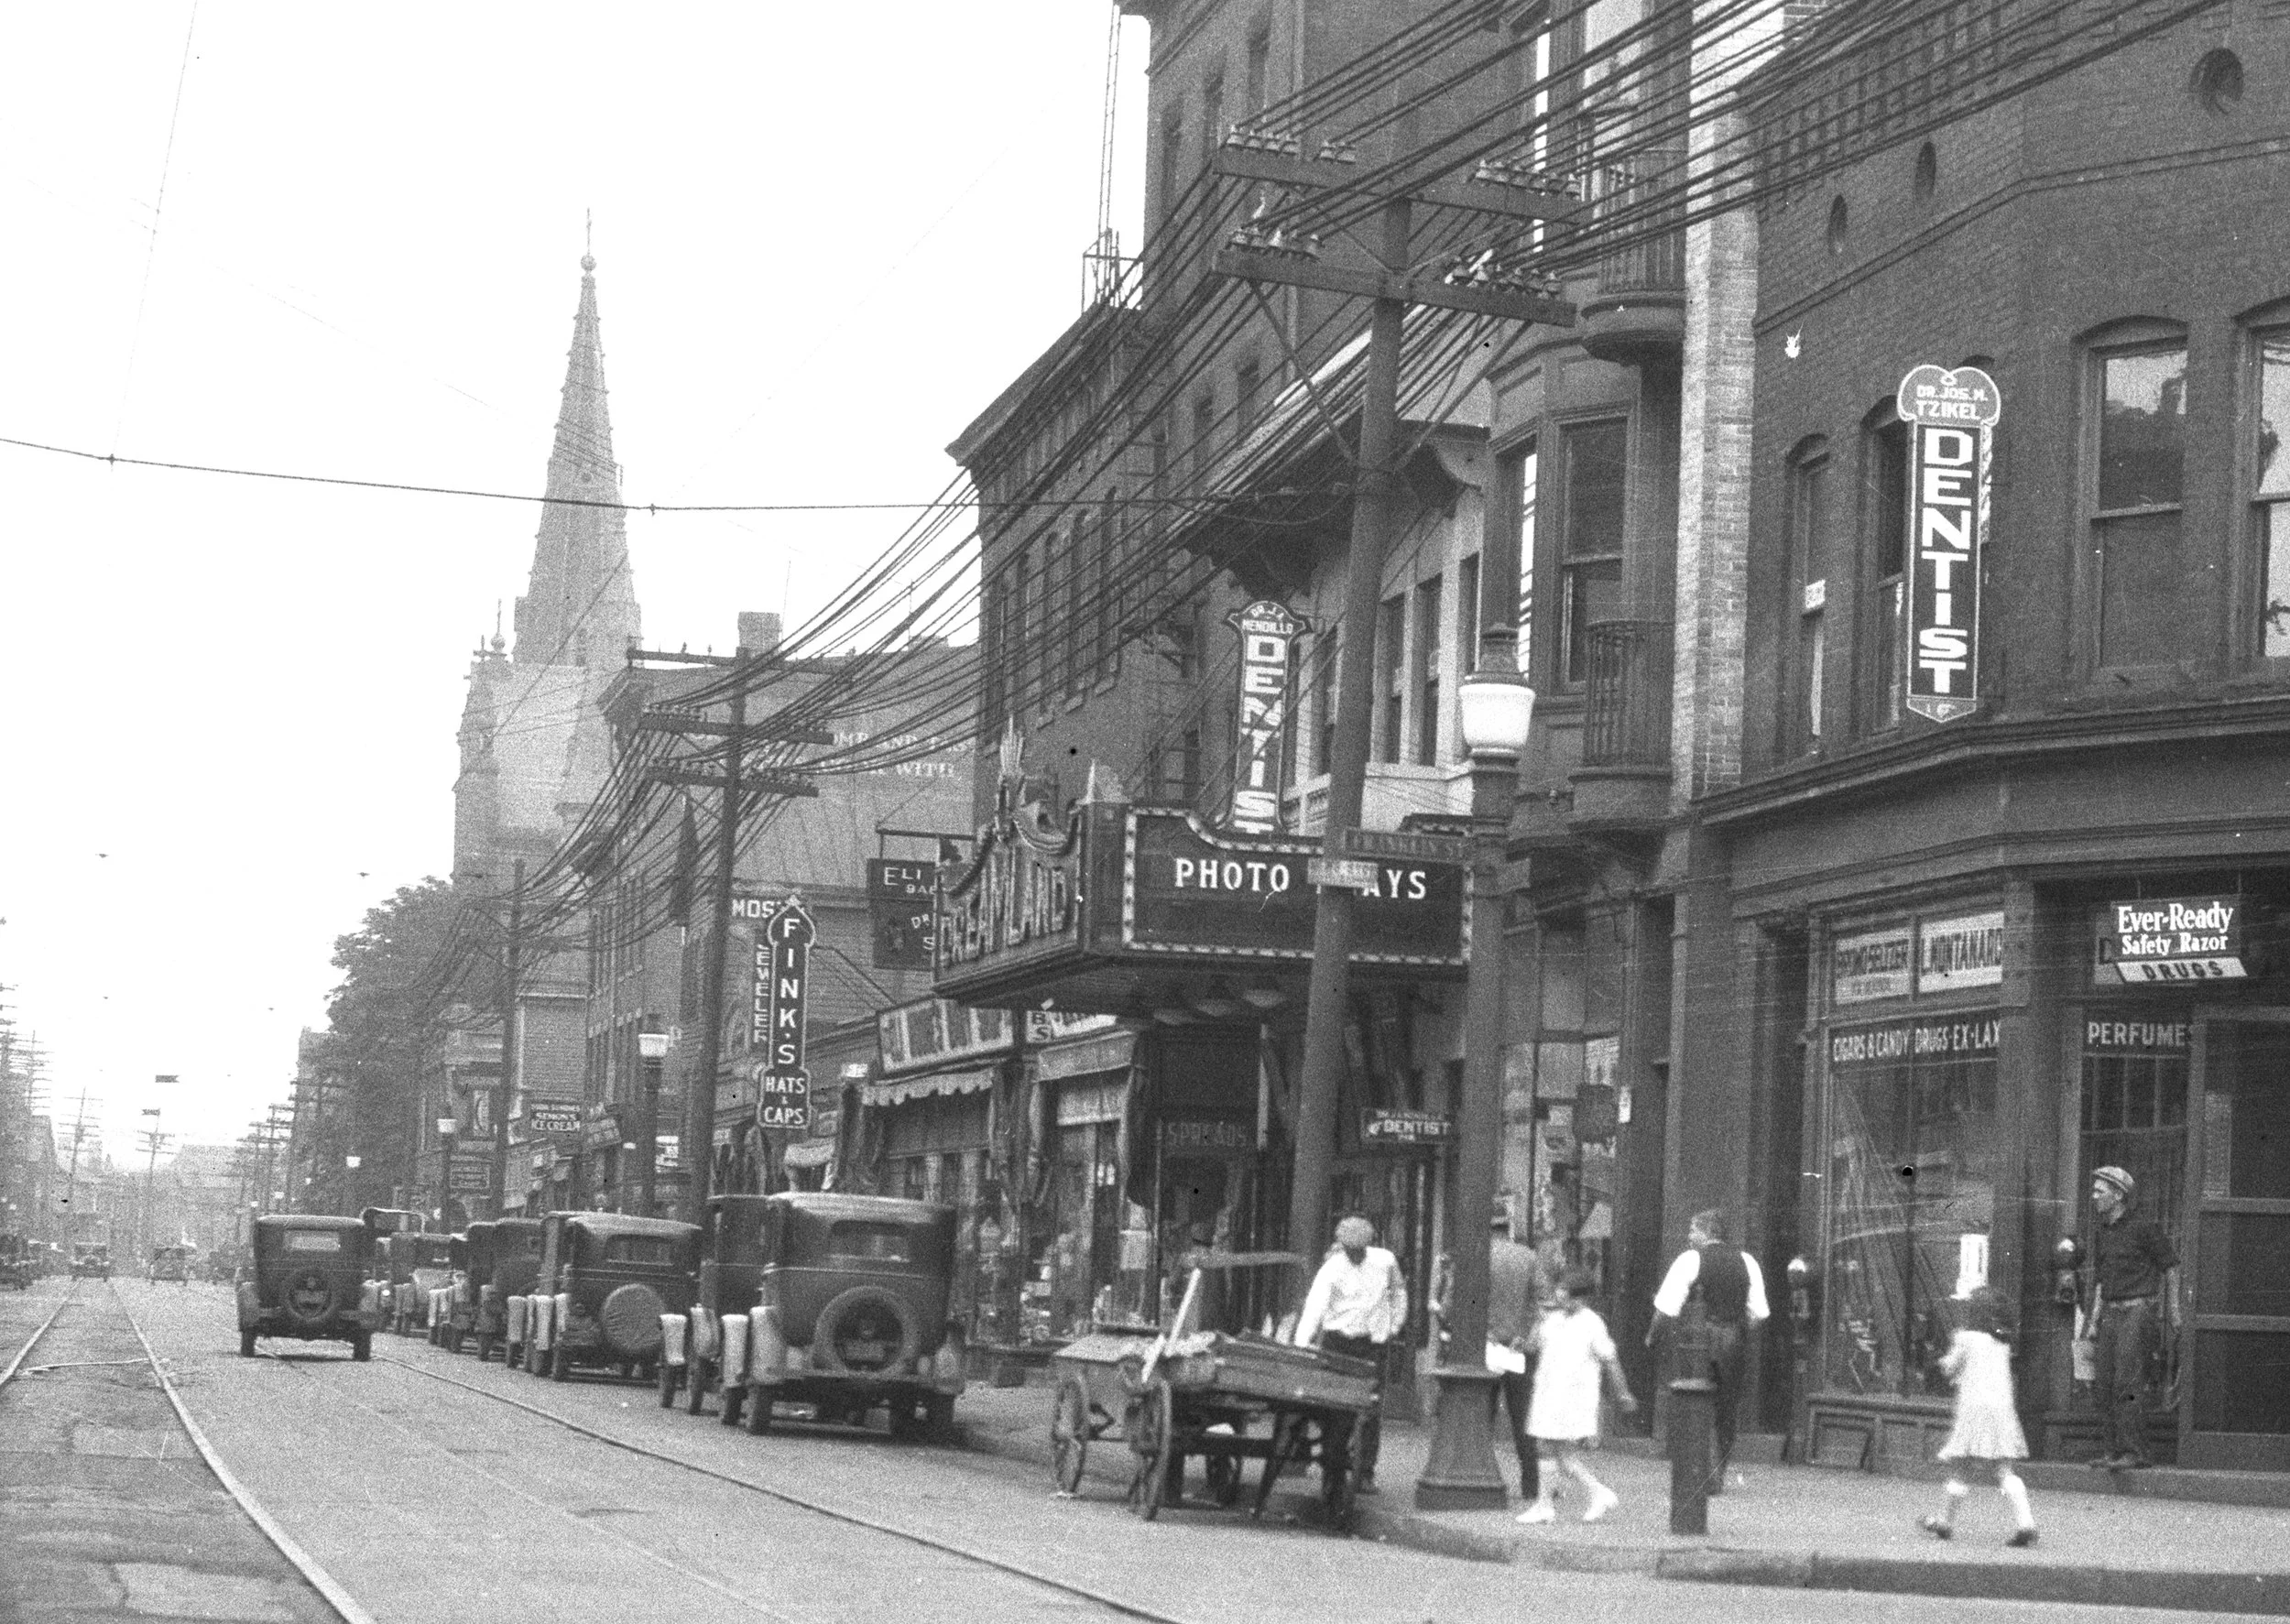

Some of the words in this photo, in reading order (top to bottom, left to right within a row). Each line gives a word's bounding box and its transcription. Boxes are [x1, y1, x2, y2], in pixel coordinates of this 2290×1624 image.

[1915, 400, 1981, 420] TZIKEL
[1919, 429, 1973, 693] DENTIST
[1234, 634, 1286, 834] DENTIST
[1174, 857, 1290, 892] PHOTO
[732, 898, 782, 919] MOS
[2118, 901, 2234, 934] Ever-Ready
[2121, 933, 2171, 955] Safety
[2179, 932, 2229, 953] Razor
[2142, 961, 2223, 980] DRUGS
[778, 918, 800, 1064] FINK'S
[1877, 1029, 1910, 1057] CANDY
[2087, 1021, 2191, 1047] PERFUME
[765, 1076, 805, 1094] HATS
[764, 1106, 804, 1124] CAPS
[1383, 1119, 1450, 1135] DENTIST
